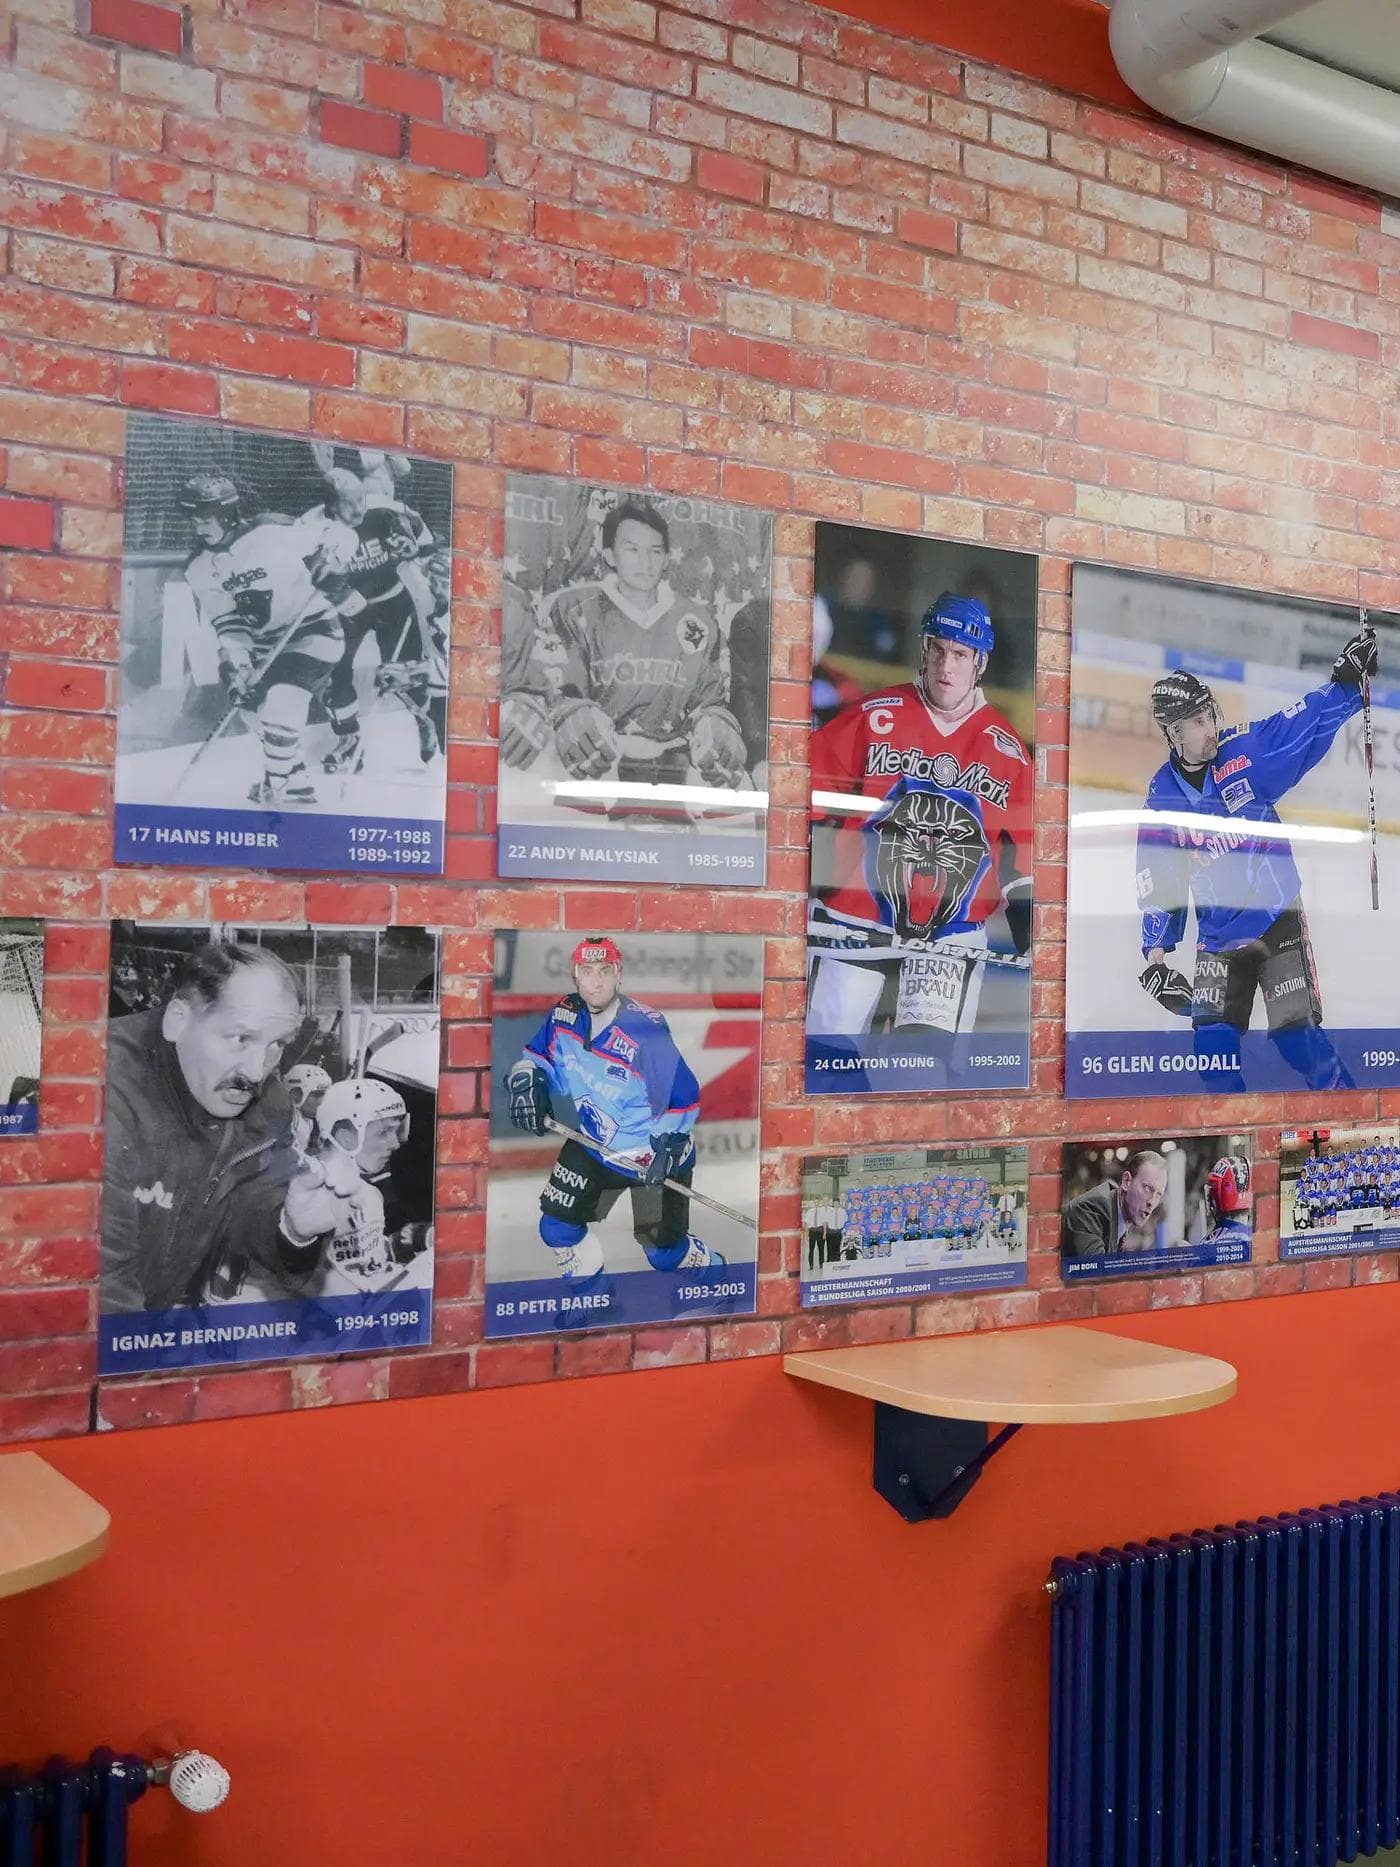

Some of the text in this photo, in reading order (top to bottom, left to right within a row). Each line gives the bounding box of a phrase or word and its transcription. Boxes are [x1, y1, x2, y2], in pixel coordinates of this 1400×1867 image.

[869, 709, 894, 734] C
[128, 827, 279, 848] 17 HANS HUBER
[349, 827, 432, 845] 1977-1988
[348, 847, 431, 864] 1989-1992
[508, 845, 755, 868] 22 ANDY MALYSIAK 1985-1995
[901, 957, 964, 981] HERRN
[905, 976, 956, 1000] BRÄU
[815, 1055, 1021, 1070] 24 CLAYTON YOUNG 1995-2002
[1082, 1056, 1102, 1074] 96
[1107, 1055, 1153, 1073] GLEN
[1159, 1053, 1241, 1072] GOODALL
[1068, 1262, 1081, 1273] JIM
[810, 1277, 893, 1293] MEISTERMANNSCHAFT
[810, 1294, 817, 1302] 2.
[818, 1289, 866, 1302] BUNDESLIGA
[866, 1287, 895, 1297] SAISON
[496, 1282, 746, 1316] 88 PETR BARES 1993-2003
[112, 1310, 419, 1351] IGNAZ BERNDANER 1994-1998
